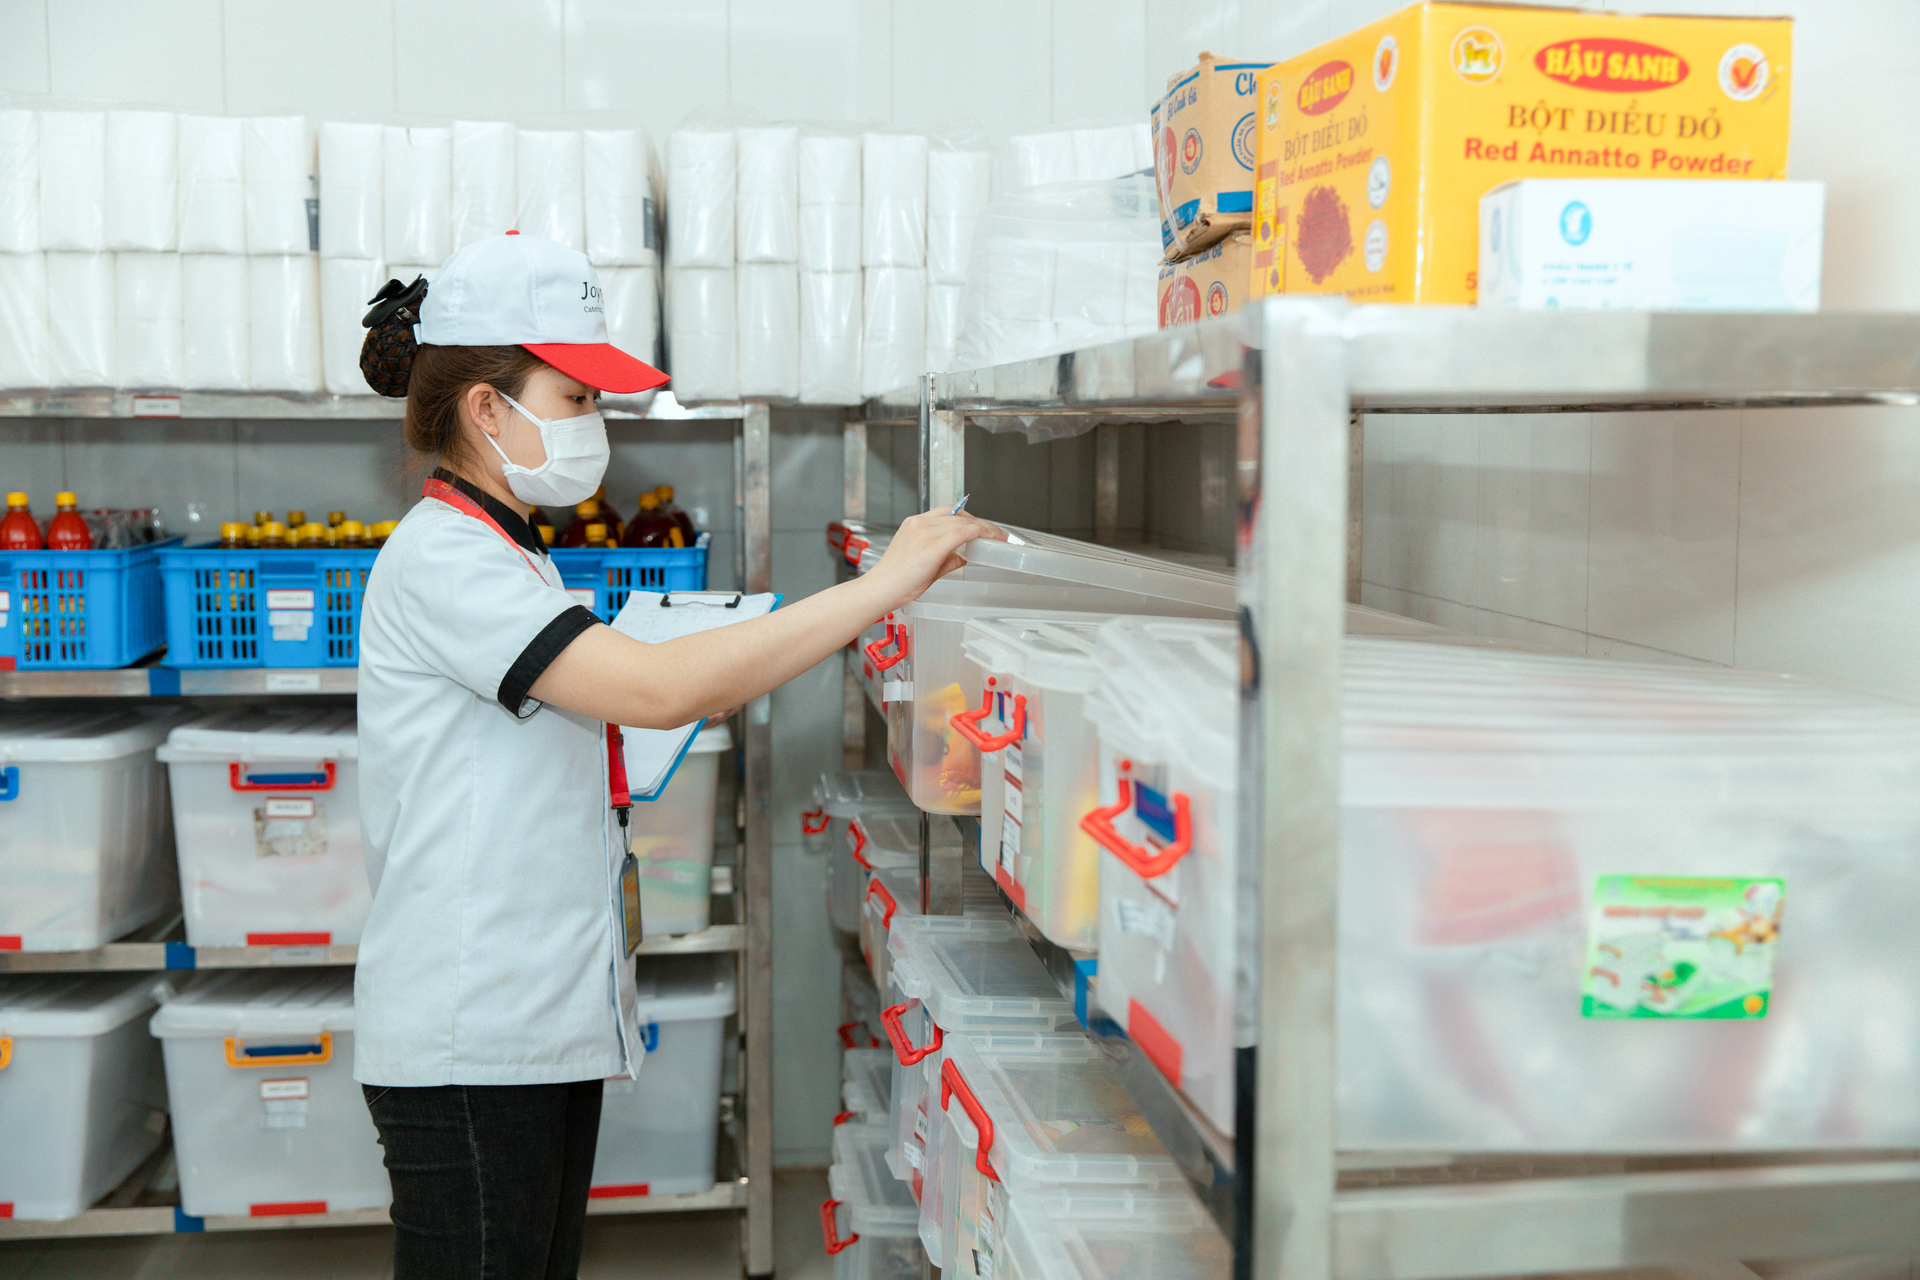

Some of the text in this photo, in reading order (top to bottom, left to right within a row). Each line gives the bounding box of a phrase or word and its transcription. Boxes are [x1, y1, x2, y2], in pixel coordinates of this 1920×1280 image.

[1545, 43, 1678, 83] HẬU SANH
[1508, 99, 1574, 136] BỘT
[1677, 106, 1722, 140] ĐỎ
[1279, 166, 1295, 188] Red
[1336, 146, 1373, 172] Powder
[1284, 131, 1308, 164] BỘT
[1465, 138, 1753, 174] Red Annatto Powder
